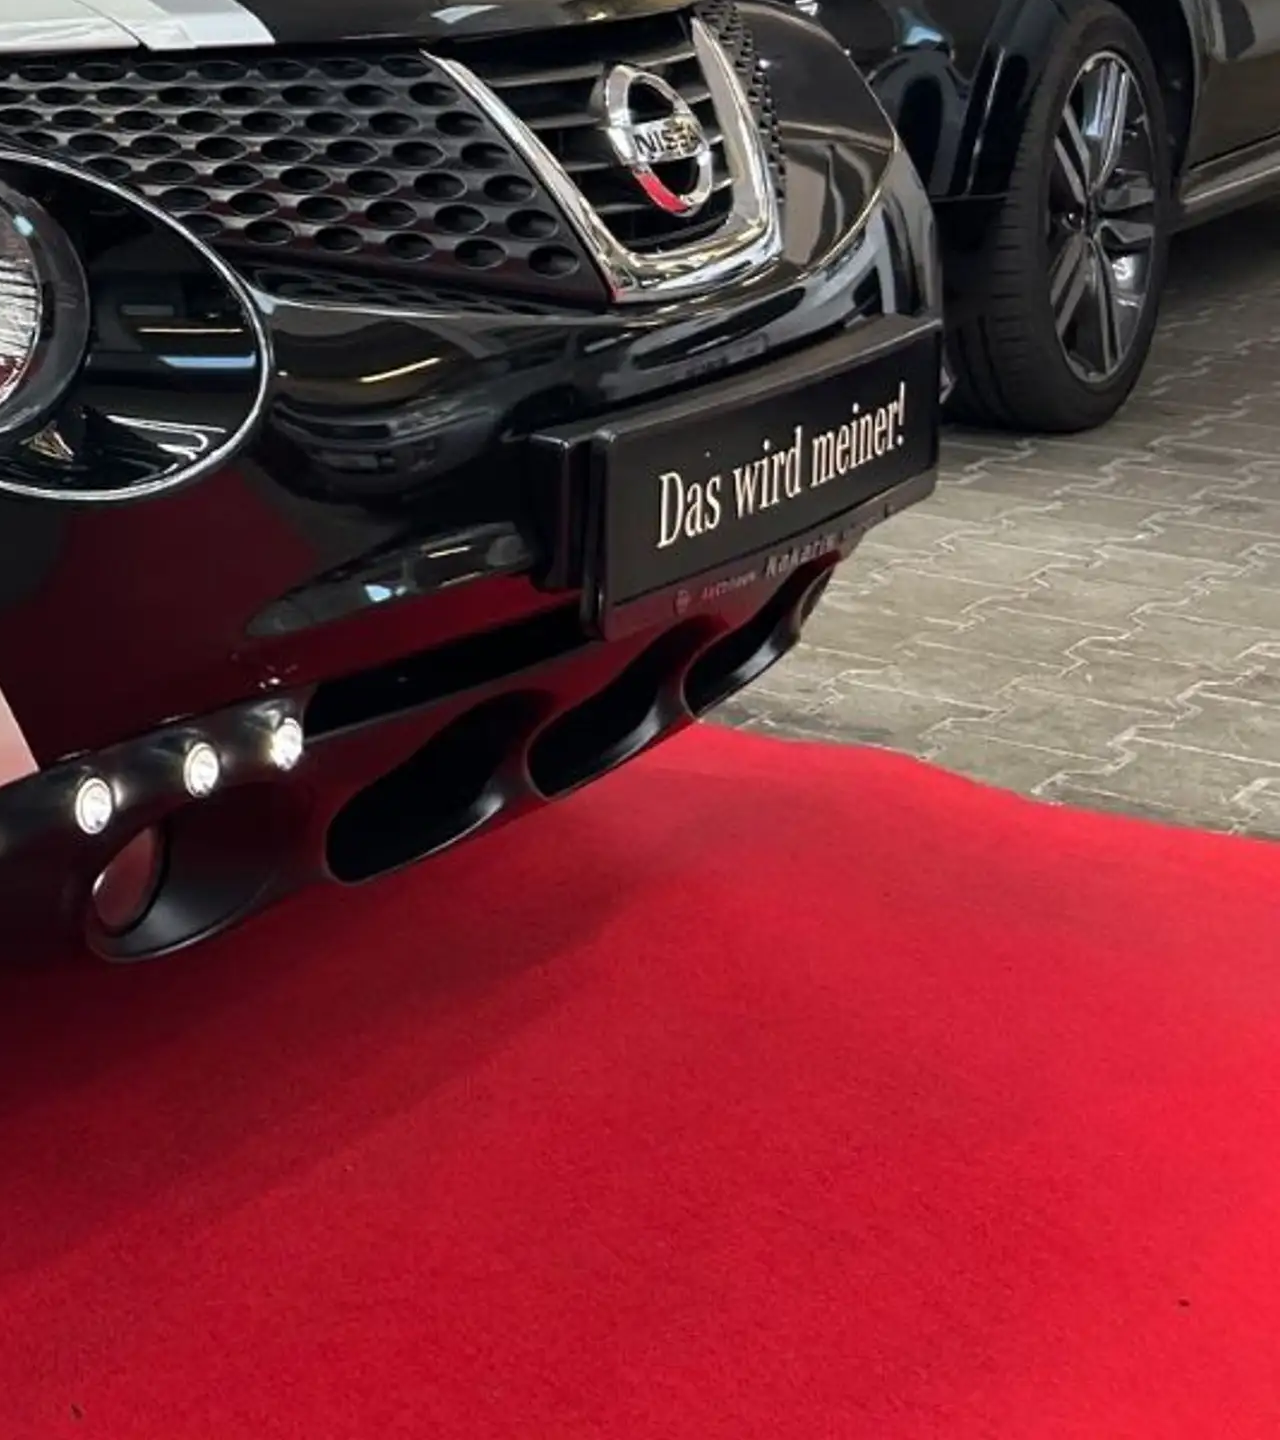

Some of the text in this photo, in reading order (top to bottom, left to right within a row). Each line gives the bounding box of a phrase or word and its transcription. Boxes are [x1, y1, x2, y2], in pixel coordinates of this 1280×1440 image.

[656, 380, 906, 549] Das wird meiner!
